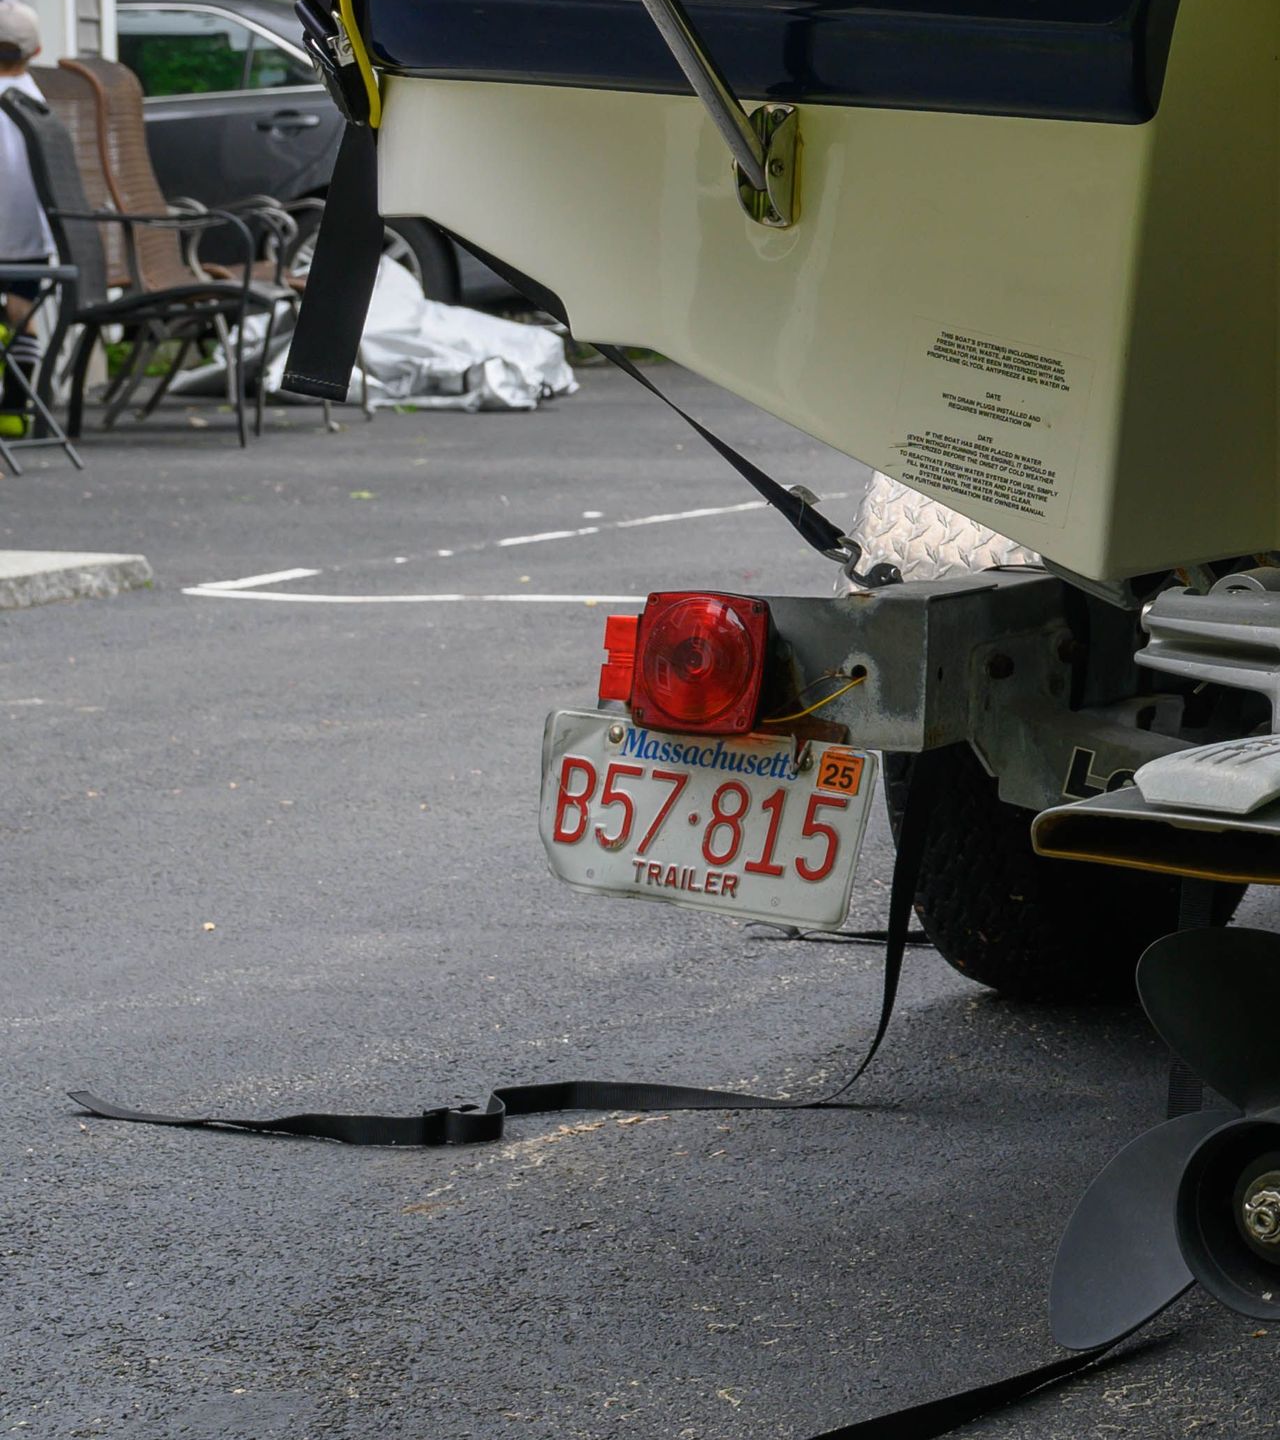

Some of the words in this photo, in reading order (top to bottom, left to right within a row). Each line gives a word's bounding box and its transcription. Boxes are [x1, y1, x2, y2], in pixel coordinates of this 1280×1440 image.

[934, 345, 969, 359] GENERATOR
[970, 354, 985, 363] HAVE
[986, 358, 1002, 367] BEEN
[1038, 371, 1053, 380] WITH
[937, 338, 955, 348] FRESH
[1002, 354, 1012, 362] AIR
[1013, 357, 1052, 372] CONDITIONER
[1053, 366, 1065, 375] AND
[941, 331, 954, 341] THIS
[1008, 348, 1039, 362] INCLUDING
[927, 351, 960, 365] PROPYLENE
[961, 359, 984, 371] GLYCOL
[986, 365, 1020, 380] ANTIFREEZE
[1040, 378, 1060, 389] WATER
[1061, 384, 1070, 392] ON
[942, 392, 956, 402] WITH
[957, 396, 976, 407] DRAIN
[976, 401, 996, 412] PLUGS
[996, 406, 1028, 419] INSTALLED
[1029, 414, 1041, 423] AND
[986, 392, 1001, 402] DATE
[948, 402, 977, 415] REQUIRES
[979, 409, 1022, 426] WINTERIZATION
[1023, 420, 1032, 428] ON
[932, 433, 943, 441] THE
[944, 436, 960, 445] BOAT
[961, 440, 973, 448] HAS
[974, 443, 989, 452] BEEN
[990, 447, 1013, 459] PLACED
[1021, 455, 1042, 466] WATER
[977, 434, 992, 444] DATE
[900, 450, 908, 458] TO
[909, 452, 943, 467] REACTIVATE
[944, 461, 963, 472] FRESH
[964, 467, 985, 478] WATER
[986, 473, 1009, 485] SYSTEM
[1010, 479, 1021, 488] FOR
[1037, 487, 1058, 498] SIMPLY
[925, 439, 951, 451] WITHOUT
[952, 446, 978, 458] RUNNING
[979, 453, 990, 461] THE
[1023, 464, 1047, 476] SHOULD
[1048, 470, 1056, 478] BE
[942, 450, 966, 462] BEFORE
[967, 457, 978, 465] THE
[979, 460, 998, 471] ONSET
[999, 465, 1007, 473] OF
[1008, 468, 1025, 477] COLD
[1026, 472, 1054, 485] WEATHER
[902, 472, 914, 481] FOR
[915, 476, 941, 489] FURTHER
[942, 483, 981, 500] INFORMATION
[982, 494, 993, 503] SEE
[994, 498, 1020, 510] OWNERS
[907, 459, 918, 467] FILL
[919, 462, 940, 473] WATER
[941, 468, 957, 478] TANK
[957, 472, 971, 482] WITH
[972, 476, 993, 488] WATER
[994, 482, 1007, 491] AND
[1007, 486, 1026, 497] FLUSH
[1027, 491, 1048, 503] ENTIRE
[920, 470, 941, 481] SYSTEM
[942, 476, 959, 486] UNTIL
[960, 481, 971, 489] THE
[972, 484, 993, 495] WATER
[994, 490, 1010, 500] RUNS
[823, 763, 854, 789] 25
[632, 859, 740, 898] TRAILER
